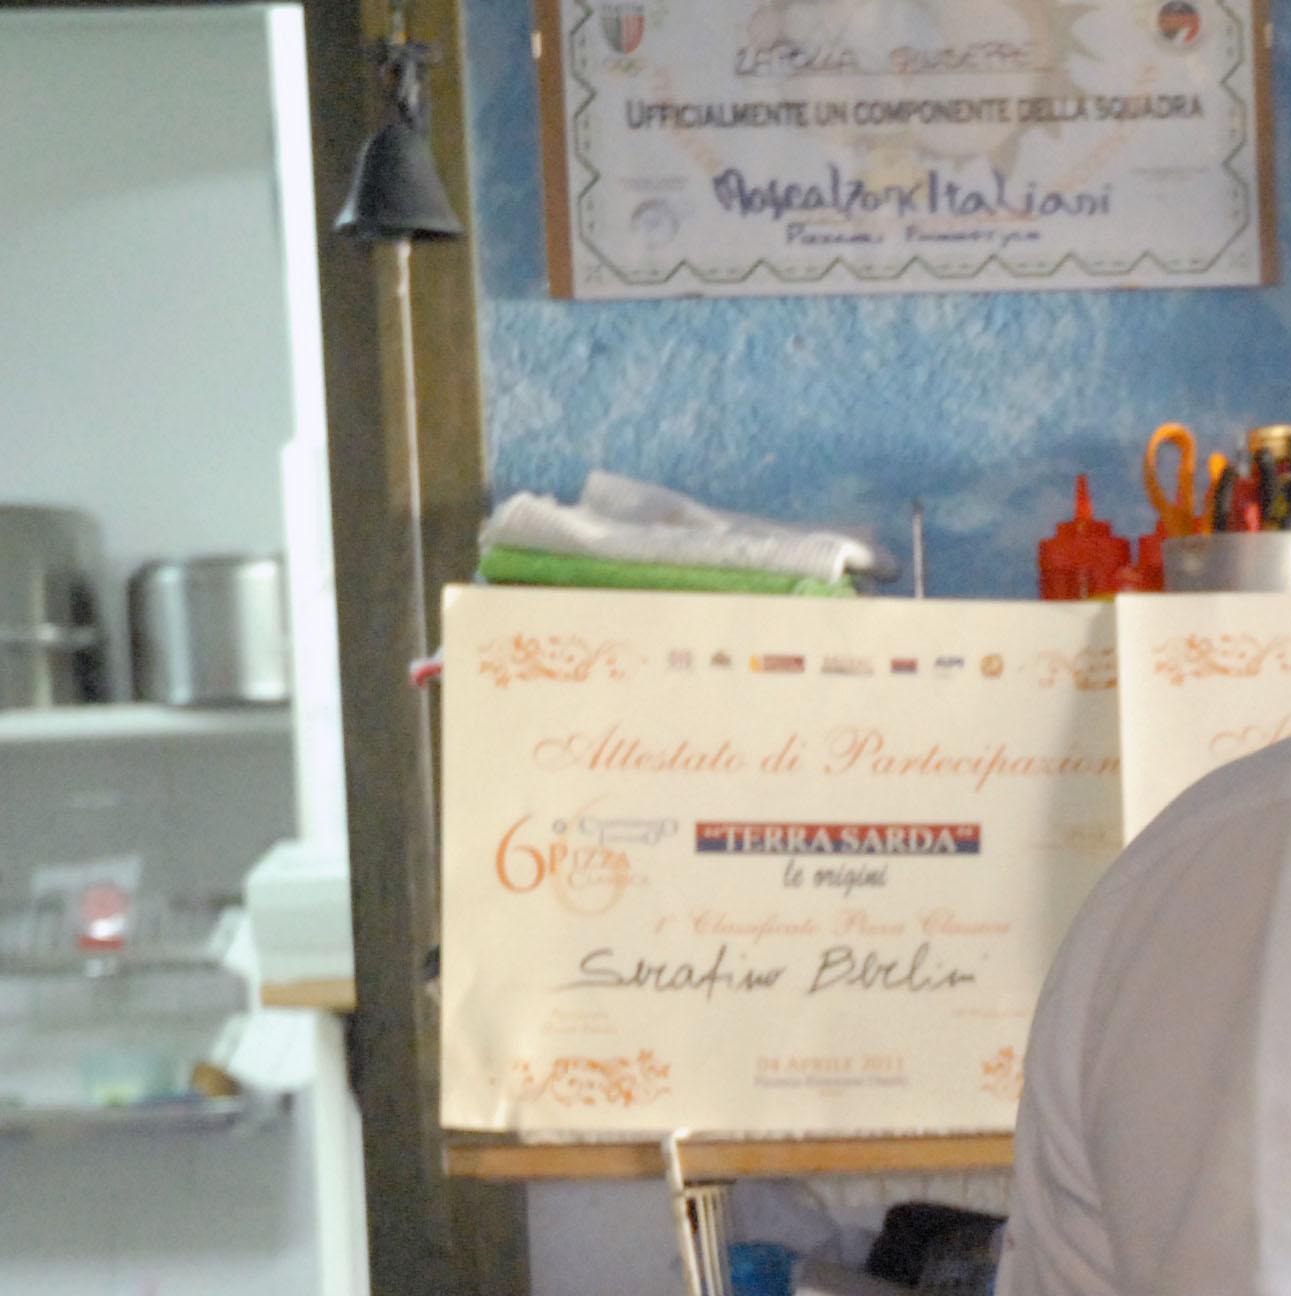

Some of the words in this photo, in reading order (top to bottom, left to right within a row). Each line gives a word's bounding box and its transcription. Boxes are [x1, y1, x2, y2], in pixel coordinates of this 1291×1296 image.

[815, 102, 848, 127] UN
[854, 98, 1009, 125] COMPONENTE
[1018, 97, 1085, 123] DELLA
[1094, 93, 1204, 121] SQUADRA
[532, 722, 747, 775] Attestato
[760, 732, 804, 775] di
[783, 857, 803, 888] le
[813, 862, 889, 898] origini
